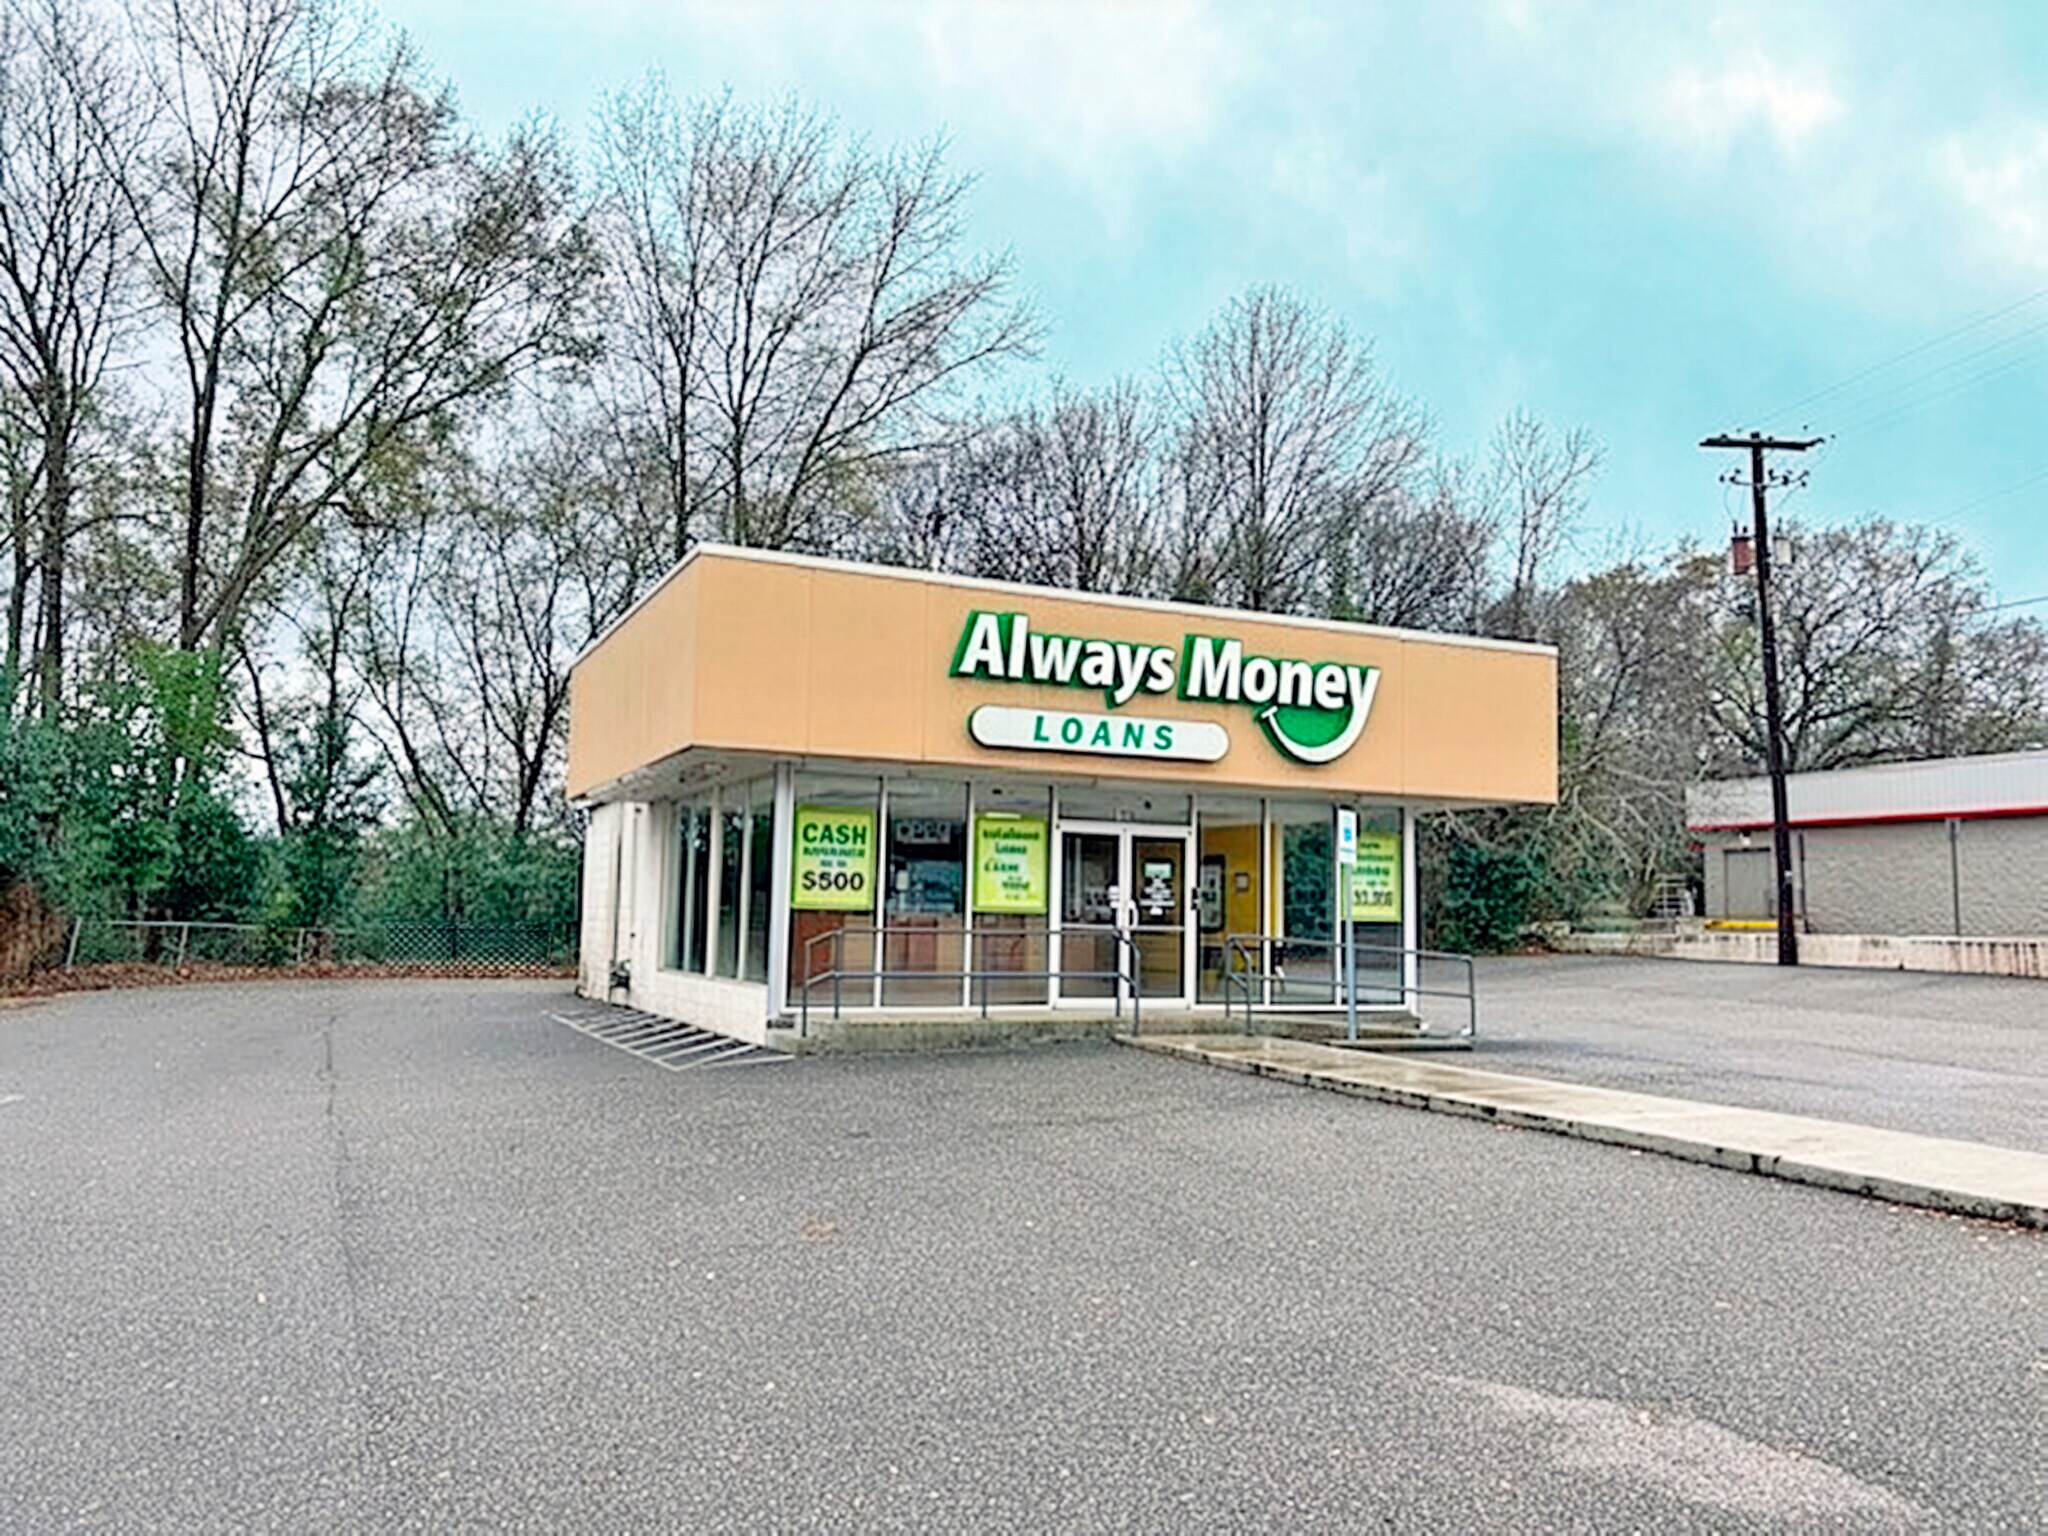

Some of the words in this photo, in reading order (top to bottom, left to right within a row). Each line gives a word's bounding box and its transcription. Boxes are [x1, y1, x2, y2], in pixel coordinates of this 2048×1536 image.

[955, 611, 1177, 706] Always
[1183, 635, 1382, 764] Money
[1033, 715, 1175, 750] LOANS
[802, 822, 867, 845] CASH
[802, 869, 864, 891] $500
